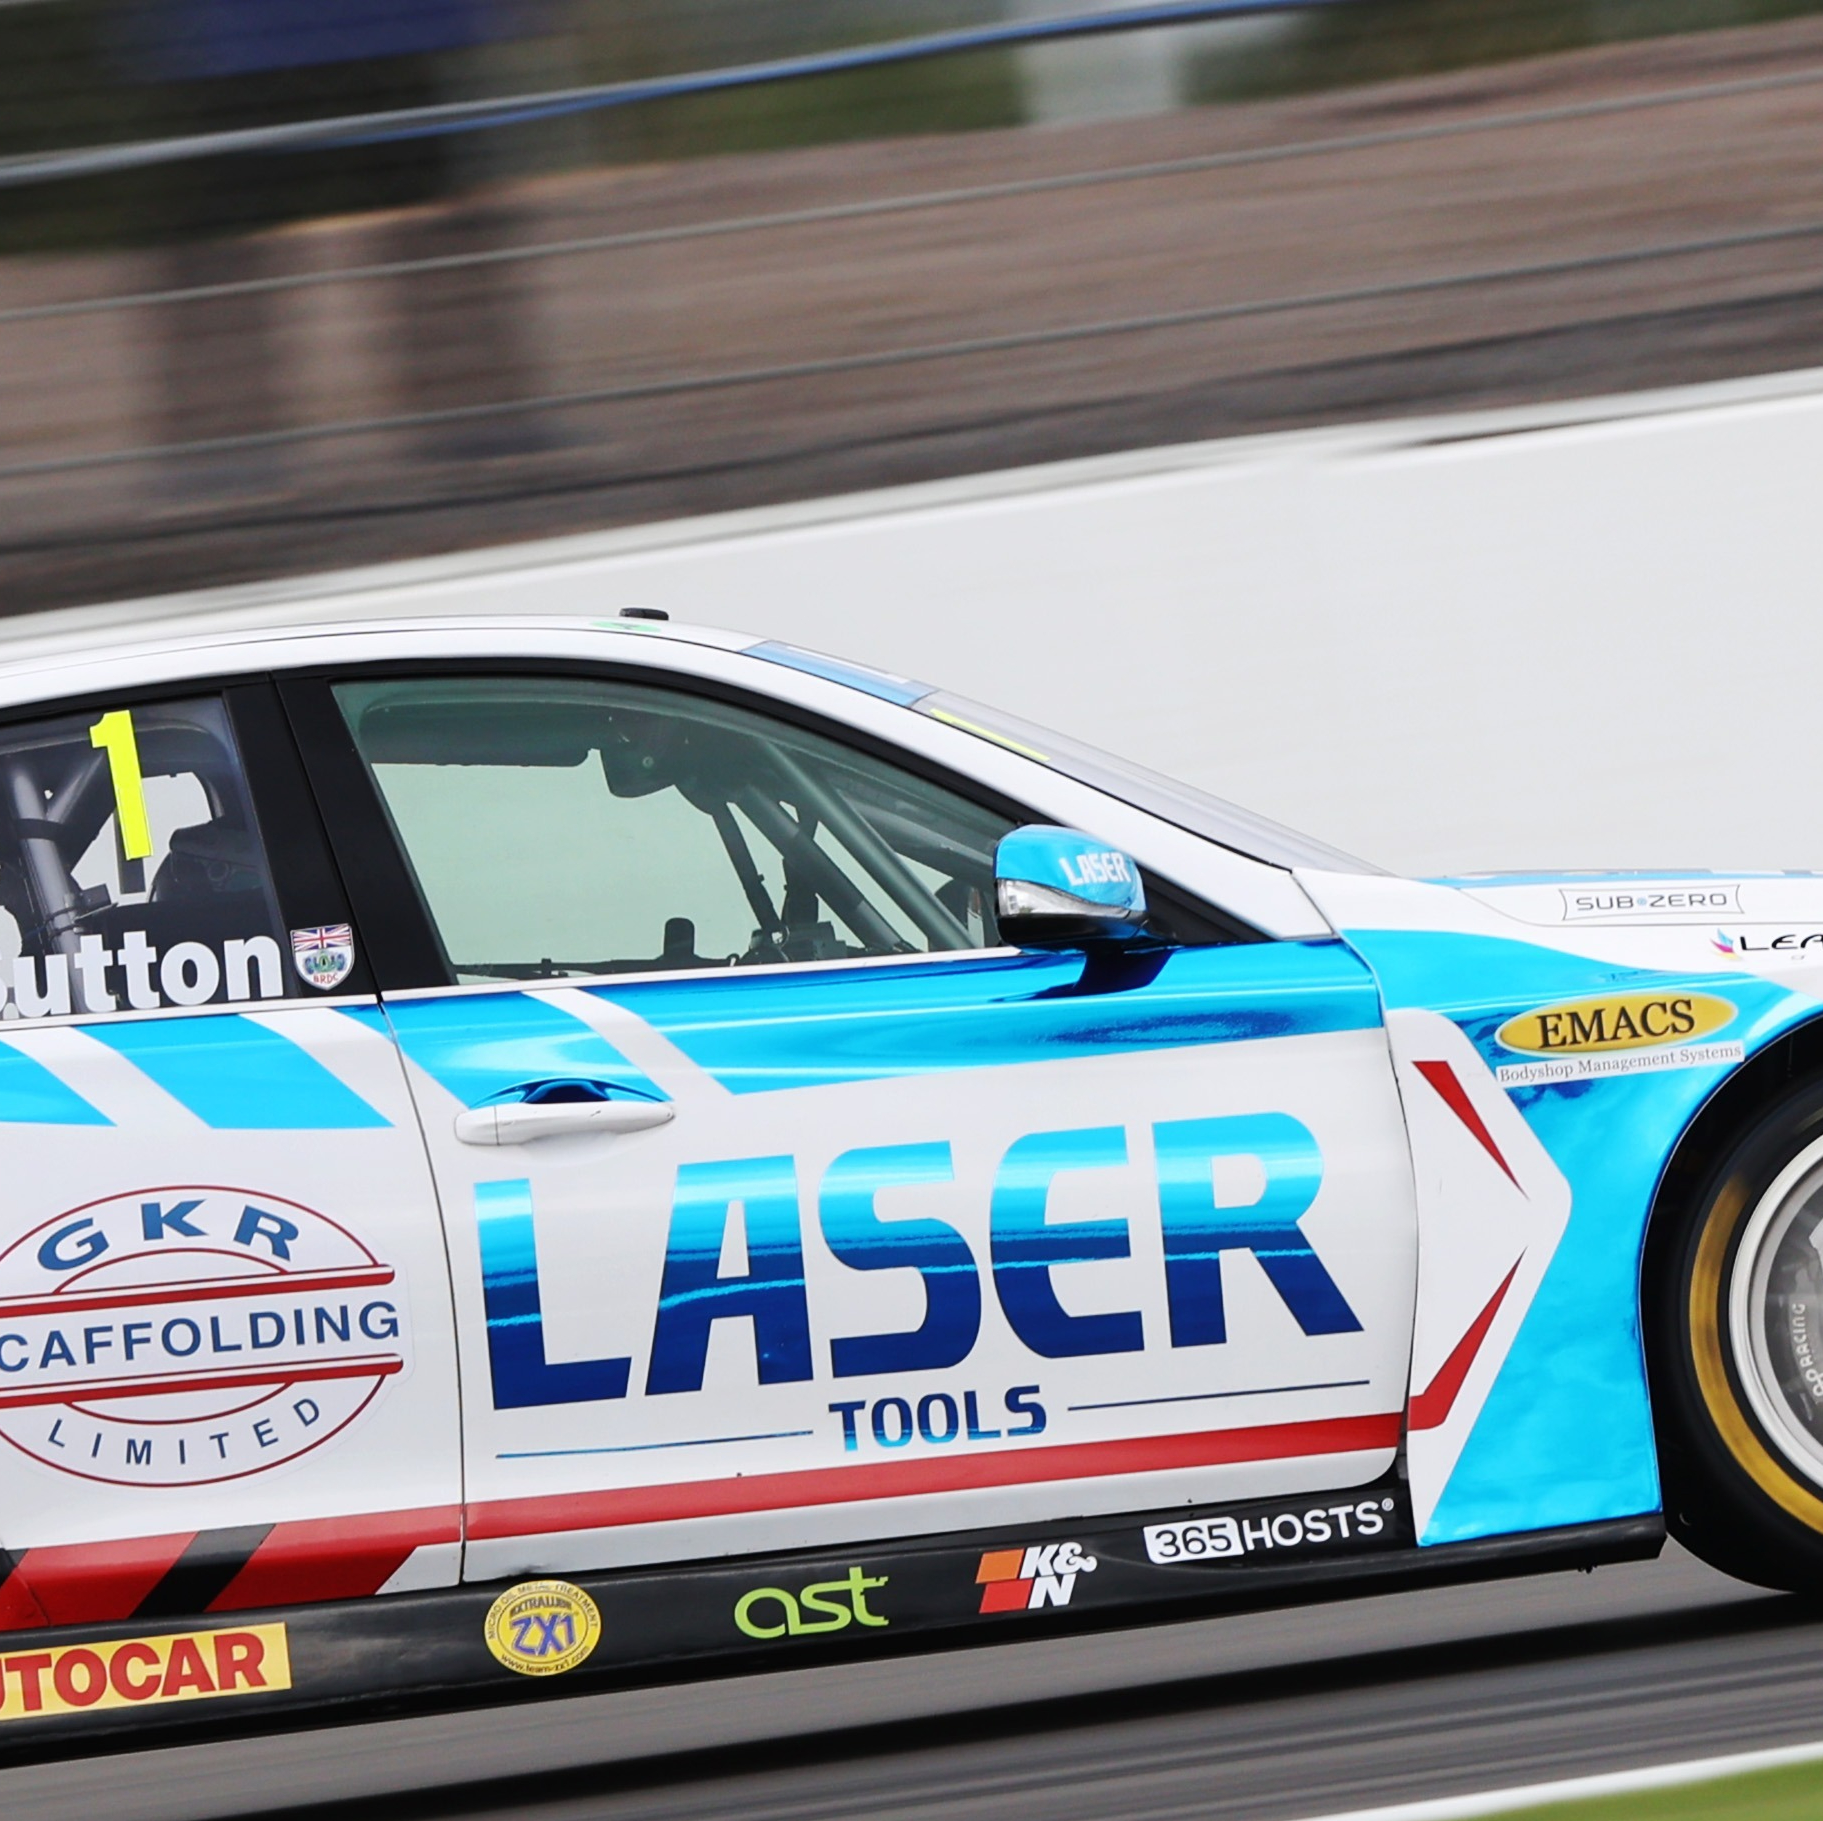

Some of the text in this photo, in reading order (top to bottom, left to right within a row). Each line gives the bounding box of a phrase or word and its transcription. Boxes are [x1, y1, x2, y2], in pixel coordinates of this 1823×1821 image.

[89, 710, 153, 860] 1
[1059, 852, 1131, 886] LASER
[1537, 998, 1695, 1050] EMACS
[1500, 1043, 1742, 1083] Bodyshop Management Systems
[37, 1199, 299, 1271] GKR
[474, 1111, 1365, 1411] LASER
[48, 1397, 320, 1466] LIMITED
[828, 1384, 1047, 1452] TOOLS
[510, 1612, 576, 1656] ZX1
[734, 1566, 889, 1639] ast
